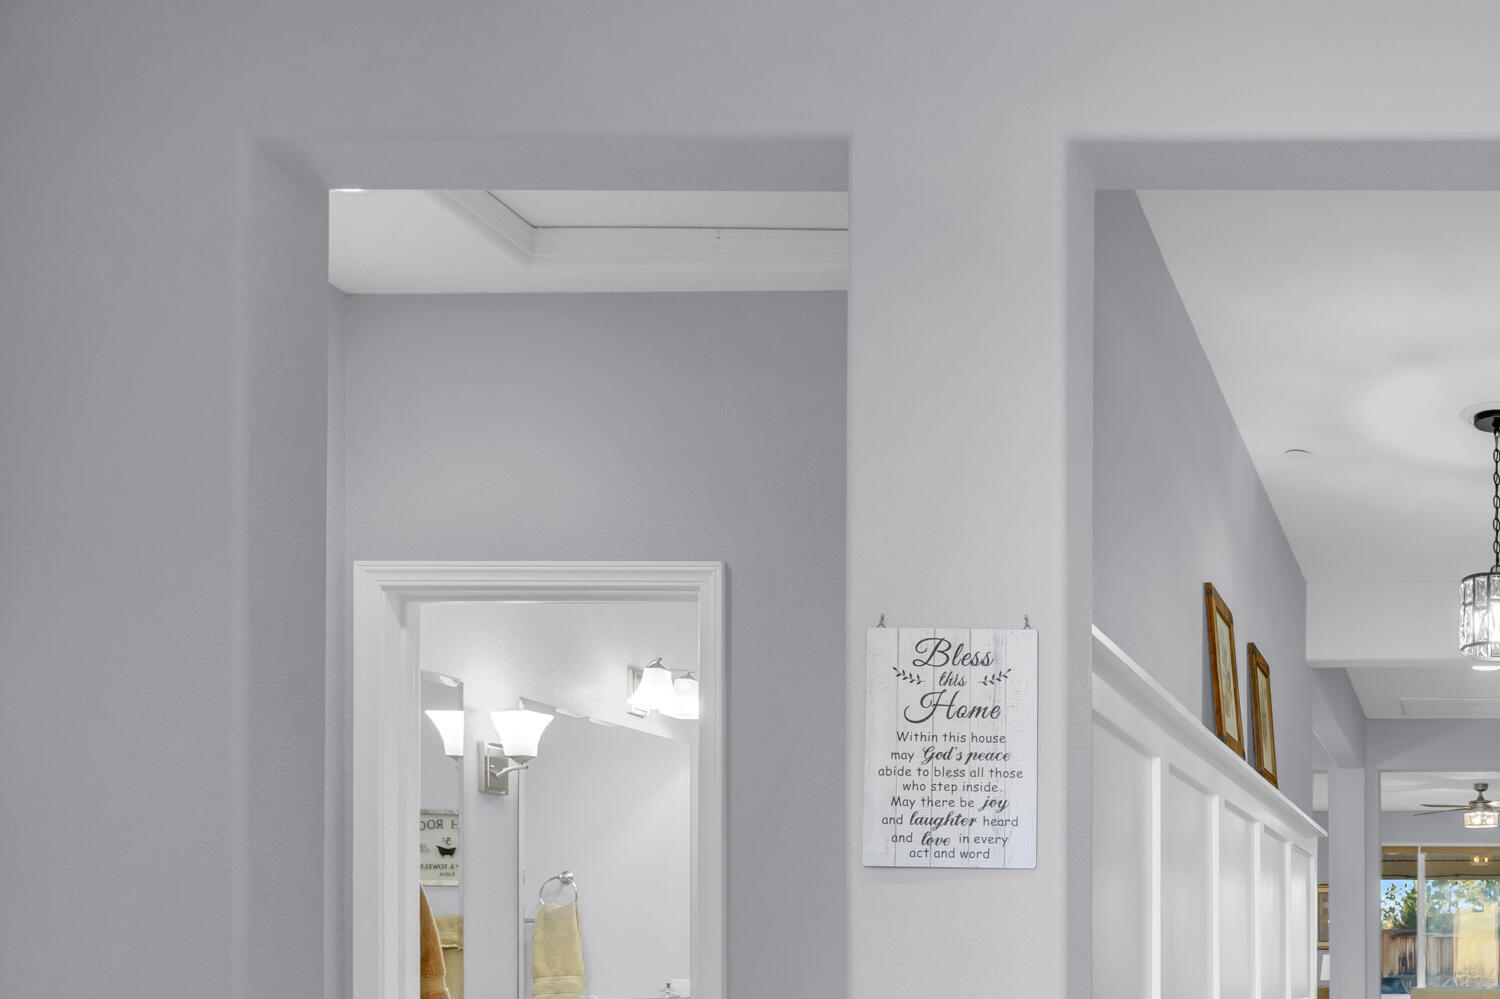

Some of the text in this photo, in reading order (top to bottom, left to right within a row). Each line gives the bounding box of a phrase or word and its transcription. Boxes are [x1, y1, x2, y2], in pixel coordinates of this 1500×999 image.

[912, 637, 994, 668] Bless
[938, 671, 967, 687] this
[903, 688, 1001, 724] Home
[896, 731, 1007, 743] Within this house
[890, 745, 1011, 765] may God's peace
[878, 766, 1024, 779] abide to bless all those
[902, 780, 1003, 794] who step inside.
[890, 795, 1010, 813] May there be joy
[881, 810, 1019, 831] and laughter heard
[891, 831, 1009, 847] and love in every
[909, 848, 990, 859] act and word
